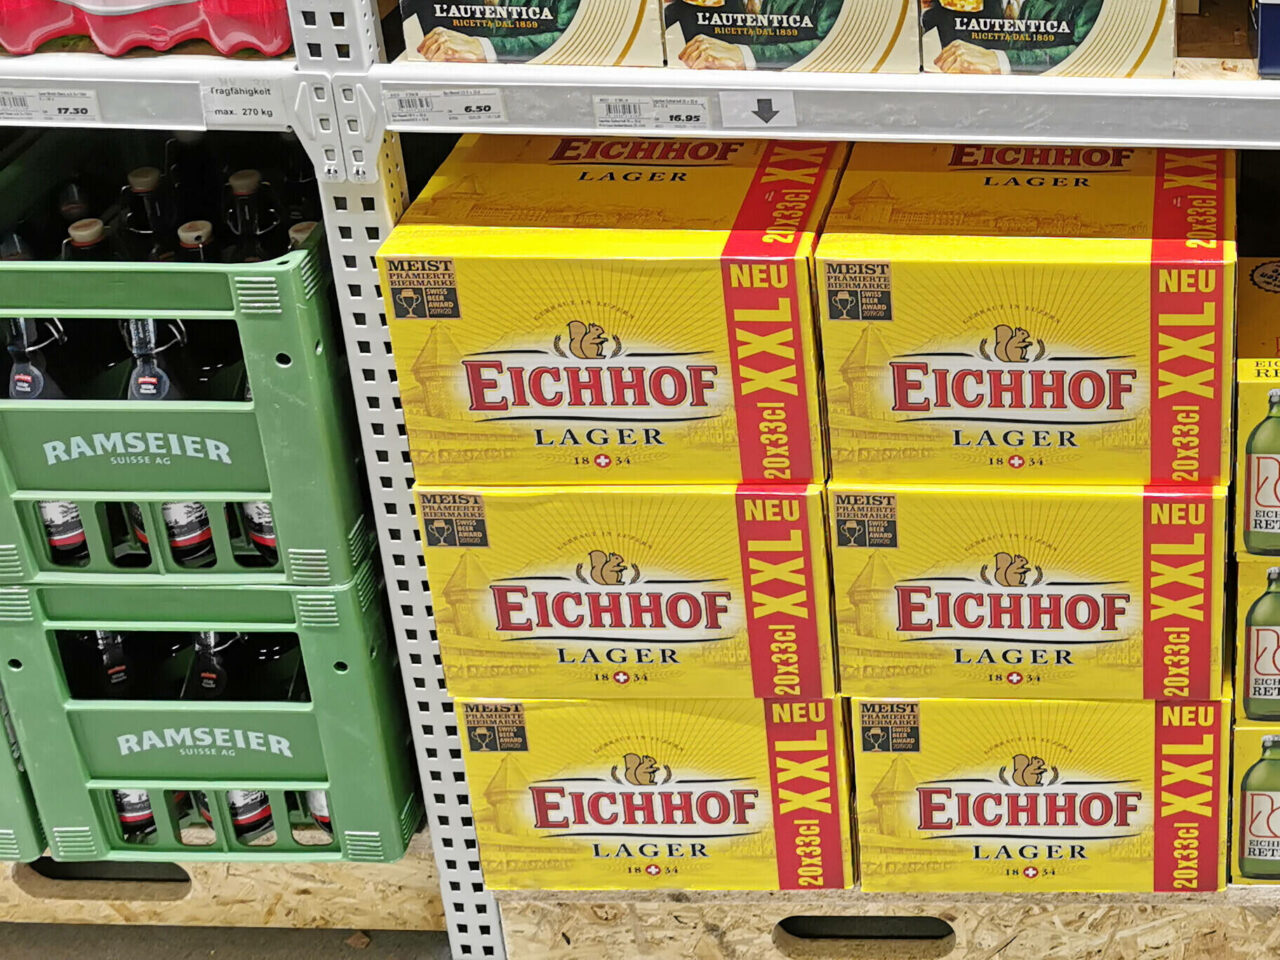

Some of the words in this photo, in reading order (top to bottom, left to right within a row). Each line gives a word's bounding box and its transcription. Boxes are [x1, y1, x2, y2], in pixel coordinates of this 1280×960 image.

[434, 3, 553, 20] L'AUTENTICA
[453, 20, 492, 28] RICETTA
[515, 21, 538, 29] 1859
[669, 114, 701, 122] 16.95
[387, 259, 452, 272] MEIST
[389, 272, 455, 280] PRÄMIERTE
[390, 279, 456, 287] BIERMARKE
[730, 264, 788, 289] NEU
[734, 298, 798, 396] XXL
[462, 360, 718, 412] EICHHOF
[889, 361, 1137, 412] EICHHOF
[535, 428, 665, 446] LAGER
[760, 402, 790, 480] 20x33cl
[953, 430, 1079, 448] LAGER
[43, 431, 232, 465] RAMSEIER
[110, 455, 151, 465] SUISSE
[155, 456, 171, 465] AG
[489, 585, 731, 632] EICHHOF
[894, 586, 1130, 632] EICHHOF
[558, 648, 680, 665] LAGER
[954, 648, 1075, 666] LAGER
[117, 727, 293, 758] RAMSEIER
[529, 786, 759, 829] EICHHOF
[916, 787, 1141, 830] EICHHOF
[593, 842, 709, 859] LAGER
[973, 844, 1088, 861] LAGER
